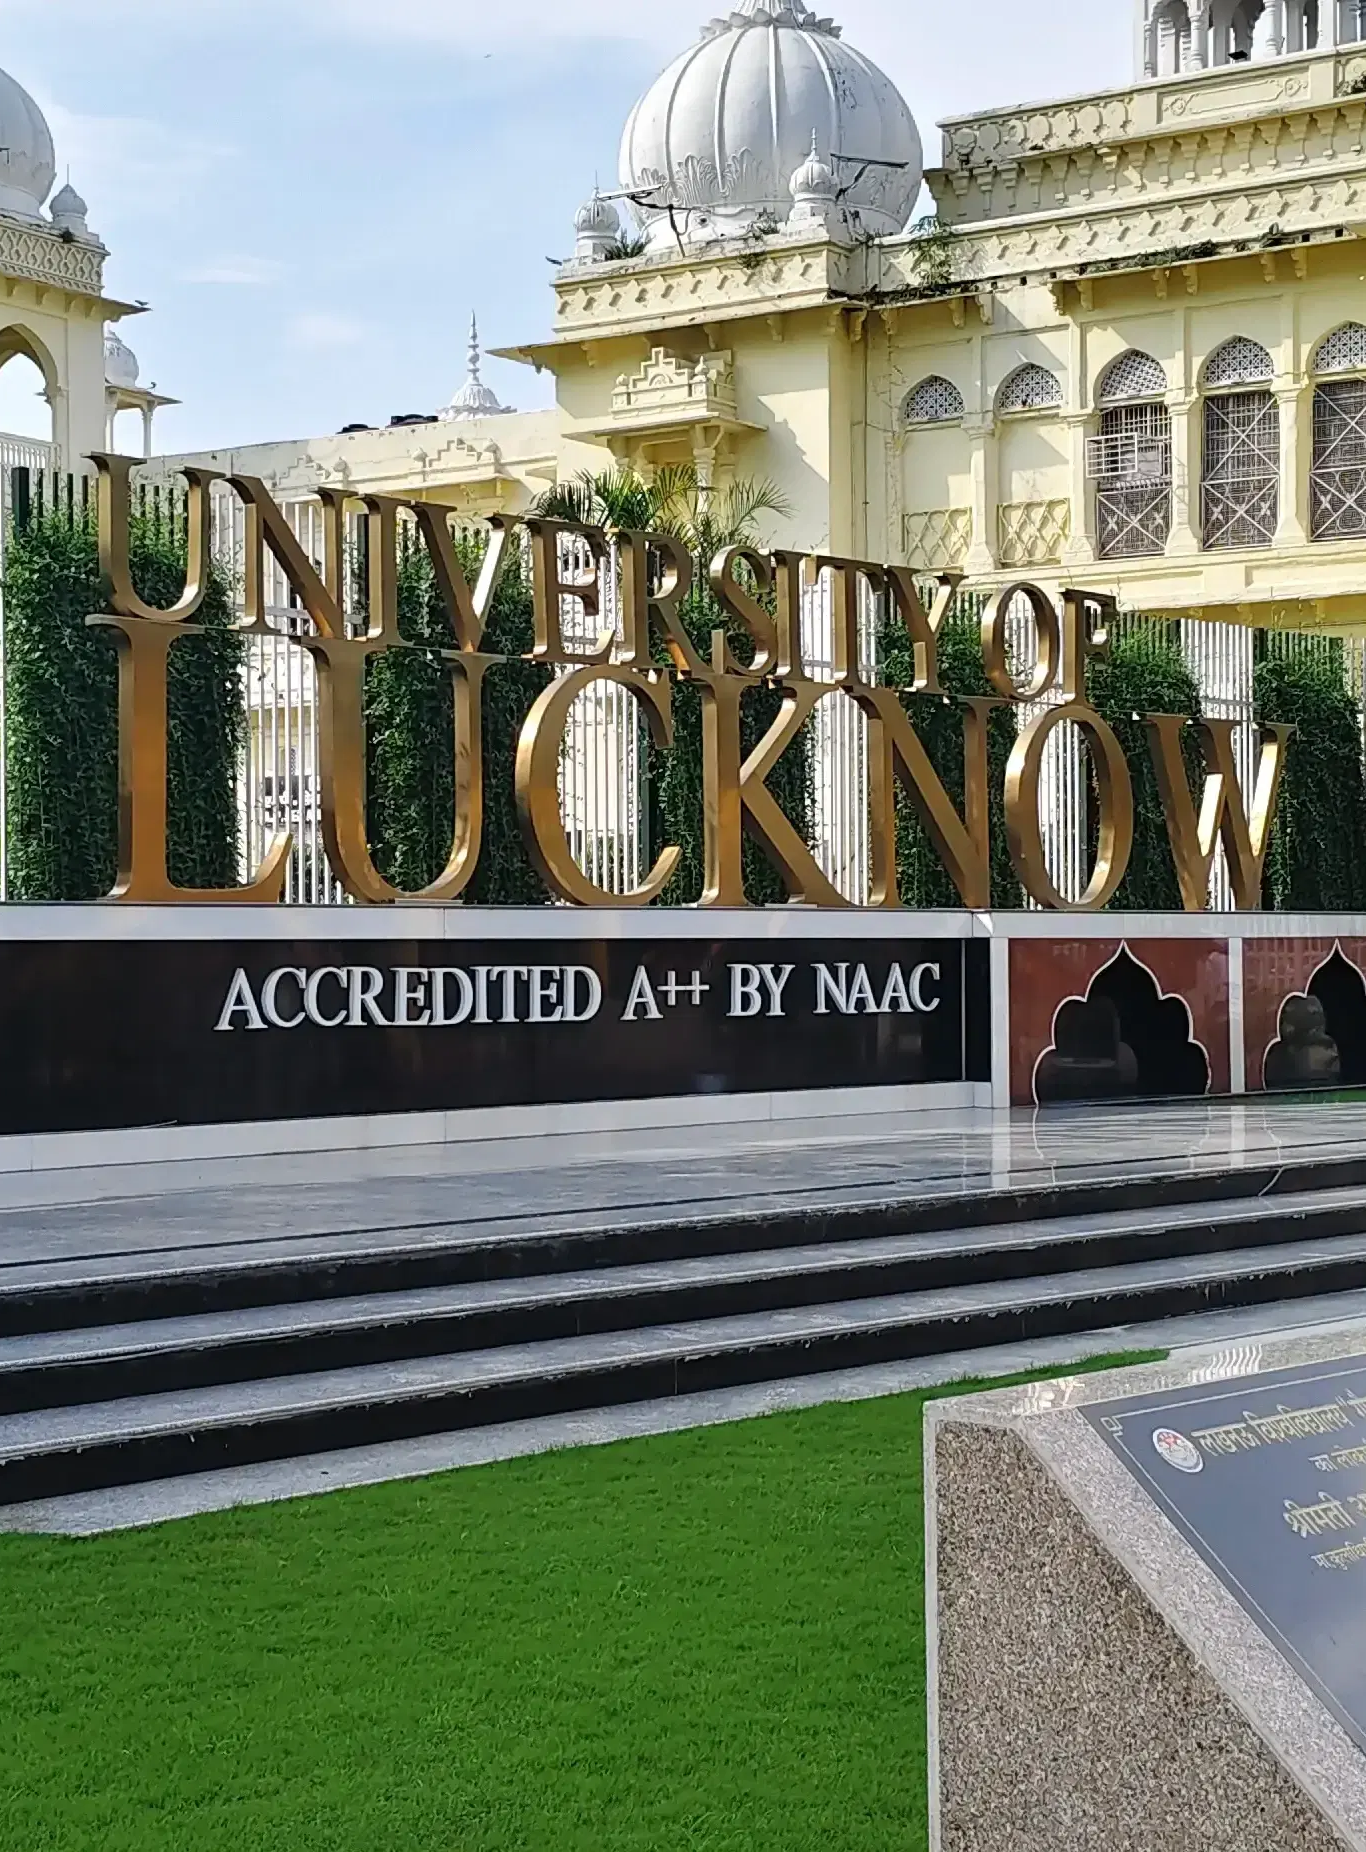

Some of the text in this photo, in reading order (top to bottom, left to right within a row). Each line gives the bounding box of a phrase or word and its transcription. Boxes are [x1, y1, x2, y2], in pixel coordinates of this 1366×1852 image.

[81, 454, 1117, 709] UNIVERSITY OF
[85, 614, 1299, 910] LUCKNOW
[213, 962, 941, 1030] ACCREDITED A++ BY NAAC
[1192, 1423, 1259, 1455] लखनऊ
[1243, 1404, 1352, 1442] विश्वविद्यालय
[1308, 1454, 1337, 1471] का
[1283, 1491, 1354, 1536] श्रीमती
